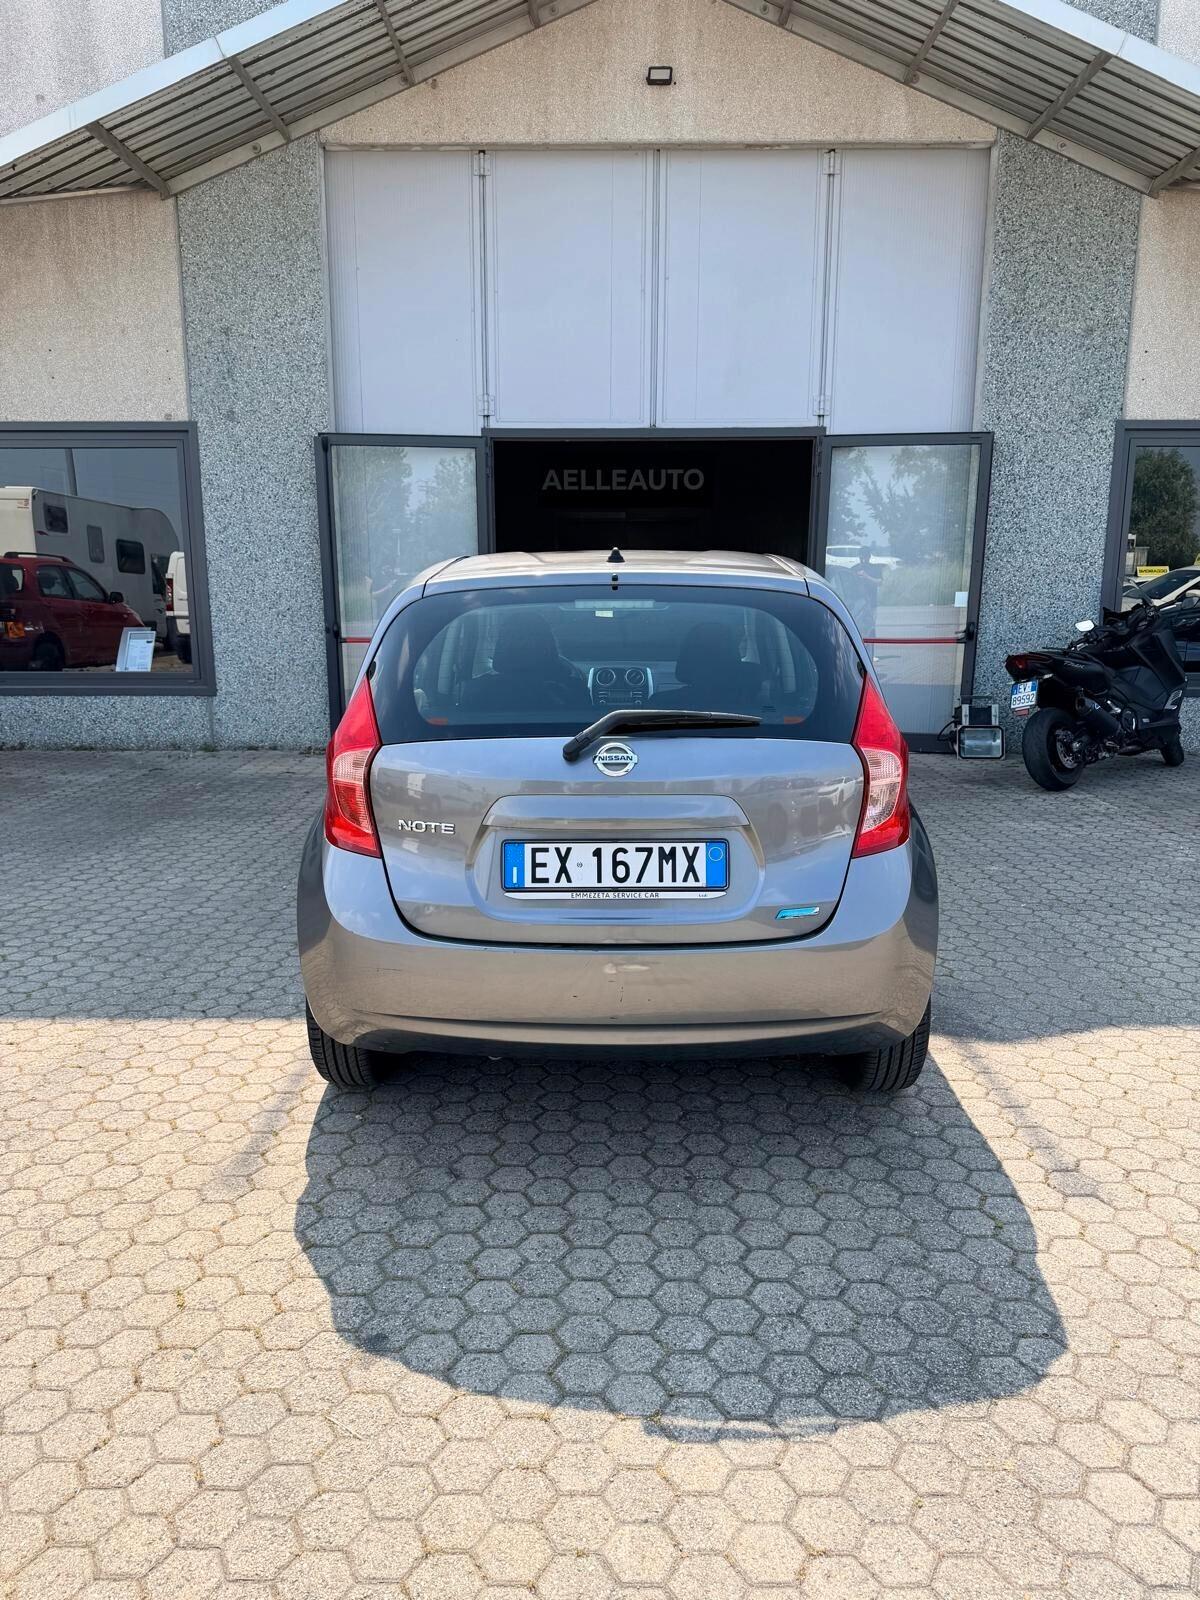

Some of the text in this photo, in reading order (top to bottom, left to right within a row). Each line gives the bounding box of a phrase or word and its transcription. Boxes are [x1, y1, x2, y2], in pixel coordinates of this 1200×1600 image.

[541, 469, 704, 490] AELLEAUTO
[398, 819, 455, 834] NOTE
[531, 846, 700, 884] EX 167MX
